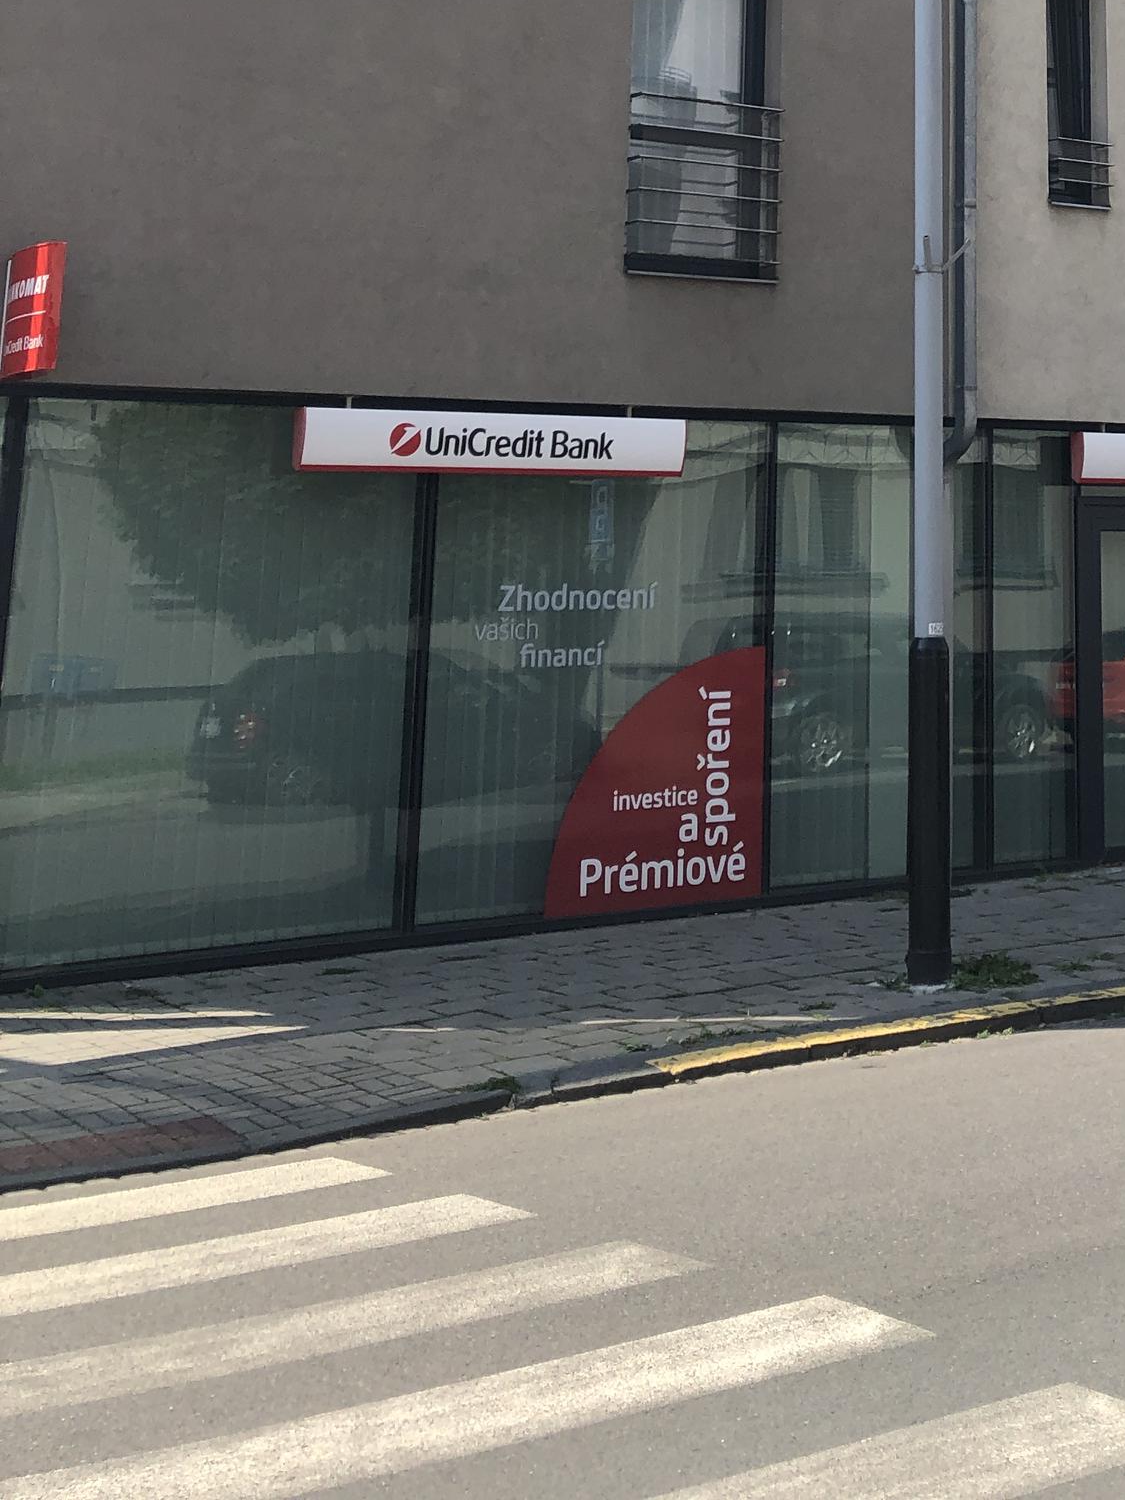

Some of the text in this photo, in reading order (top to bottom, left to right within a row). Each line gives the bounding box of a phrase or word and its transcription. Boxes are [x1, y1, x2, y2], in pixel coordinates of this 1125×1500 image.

[23, 333, 44, 350] Bank
[425, 426, 615, 460] UniCredit Bank
[498, 581, 659, 612] Zhodnocení
[475, 616, 539, 641] vašich
[520, 640, 605, 668] financí
[697, 686, 736, 847] spoření
[613, 785, 698, 812] investice
[678, 812, 698, 843] a
[579, 840, 746, 898] Prémiové
